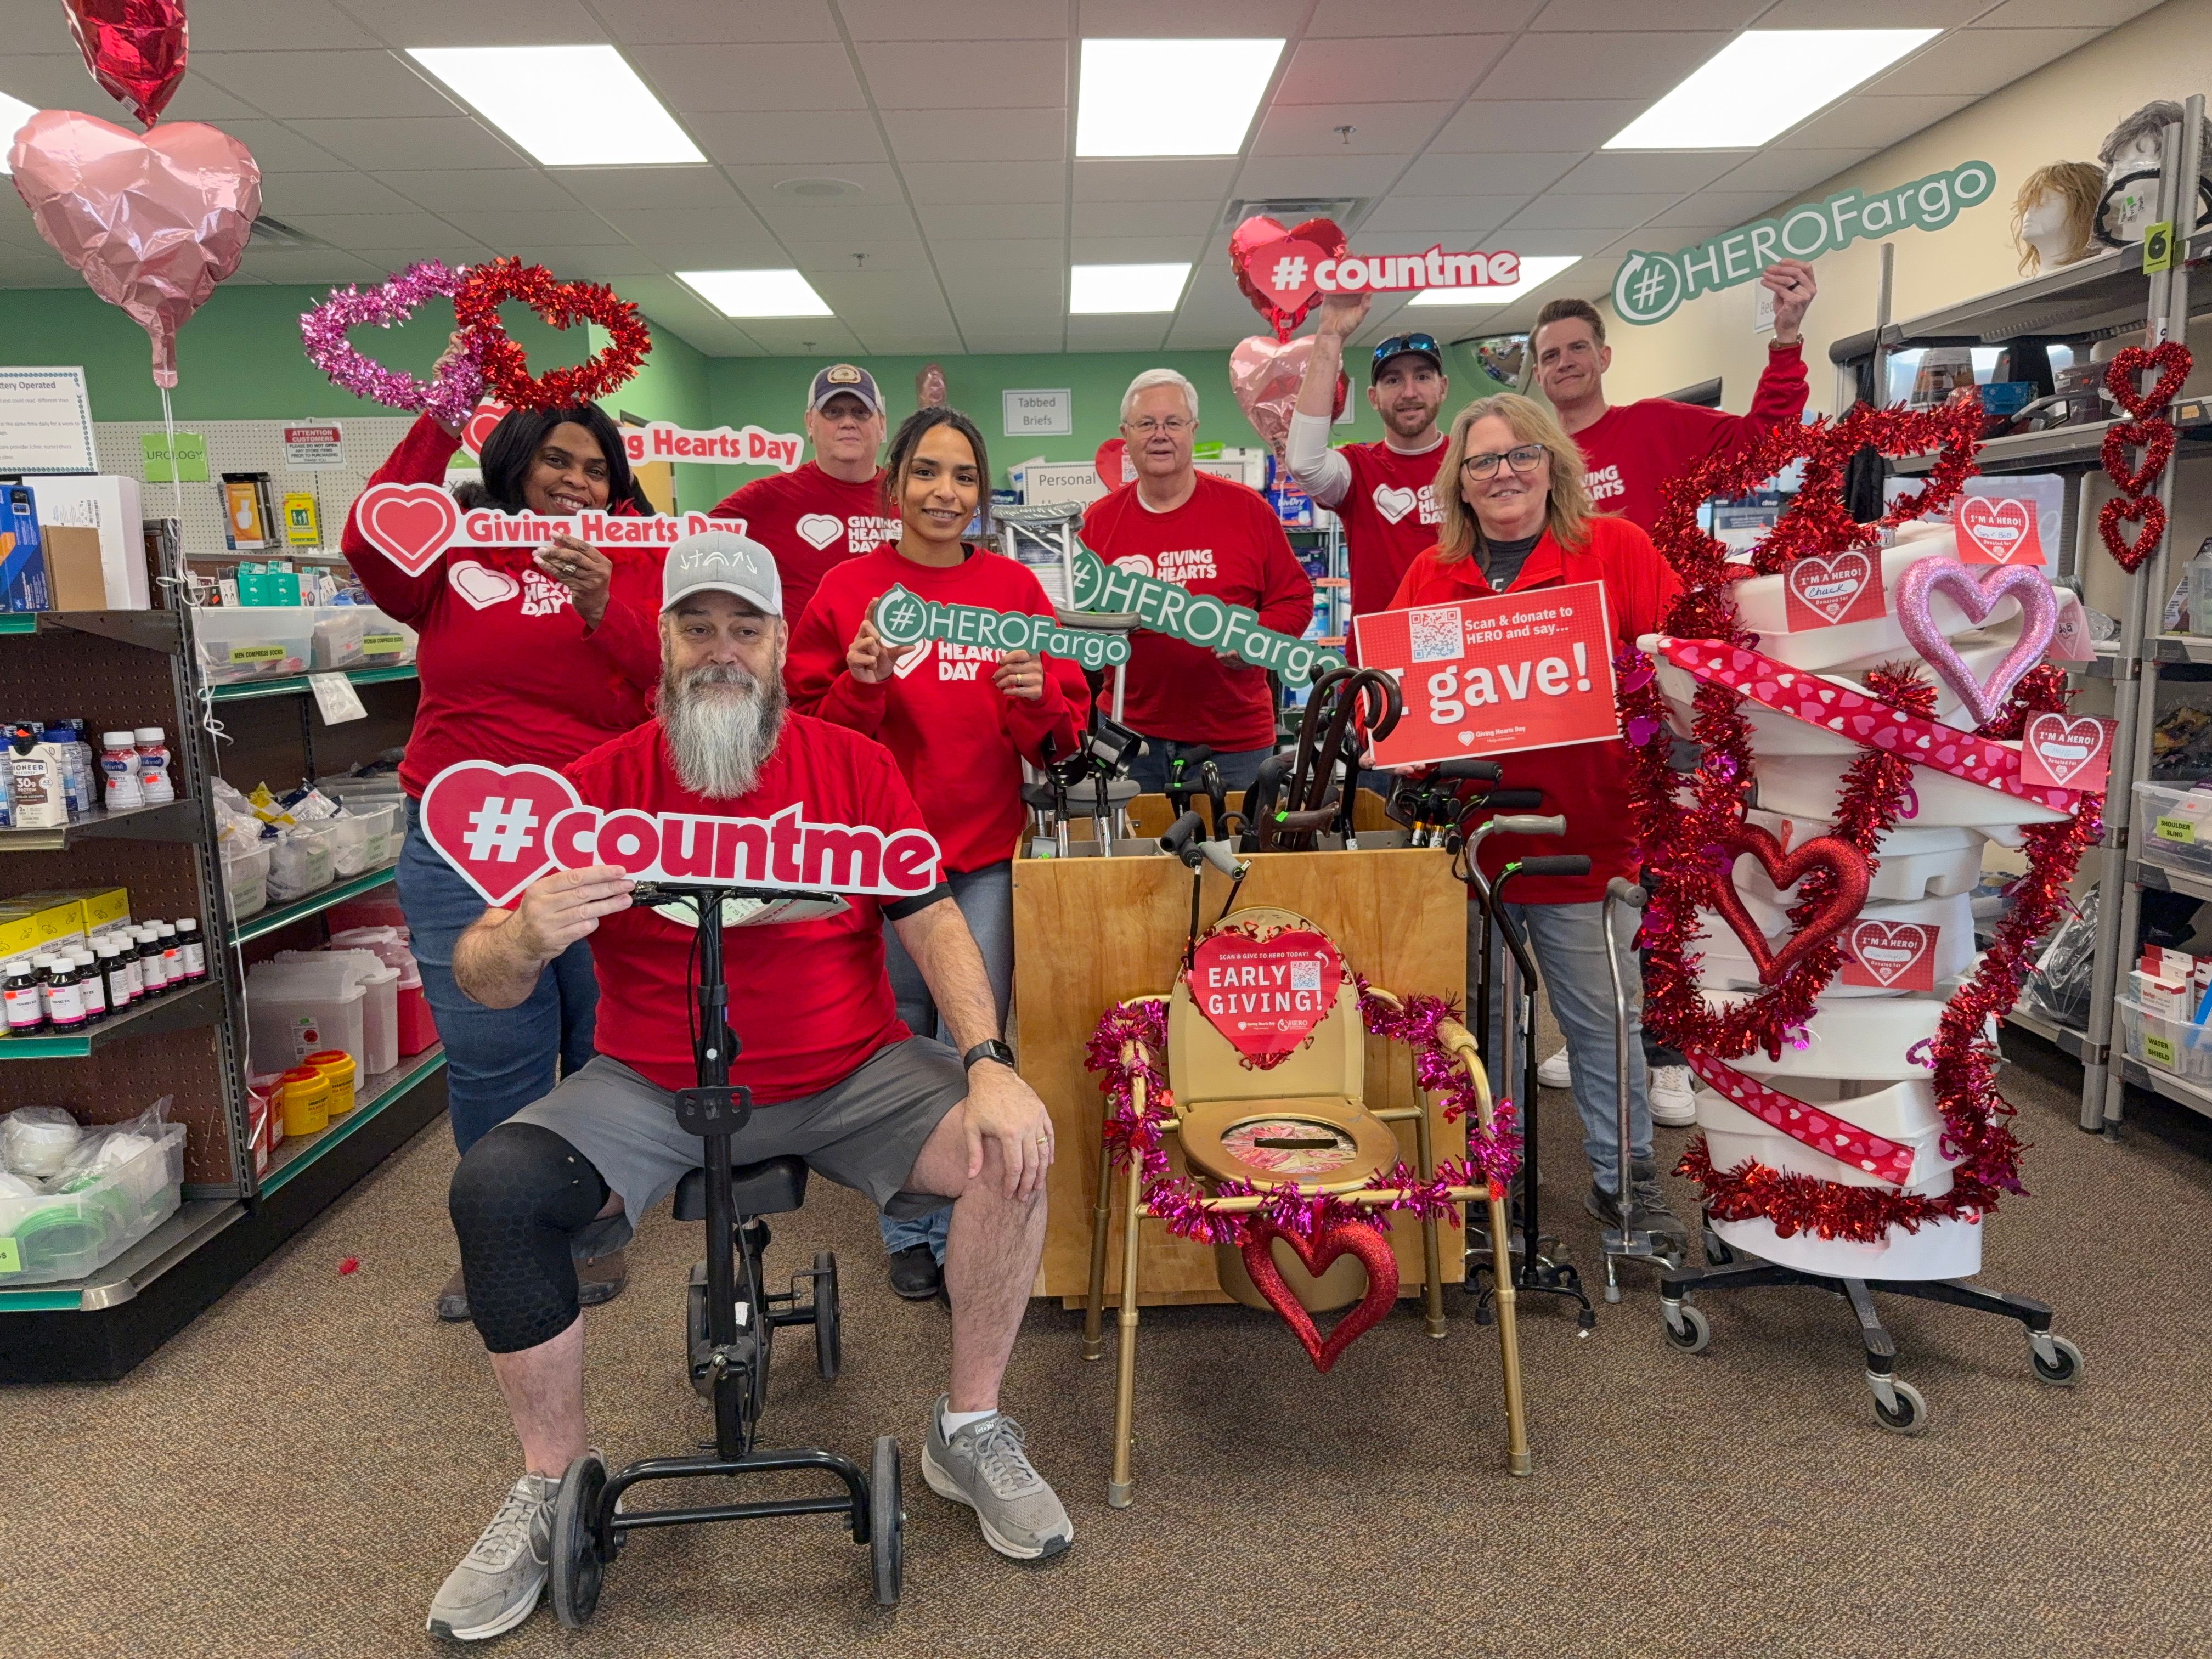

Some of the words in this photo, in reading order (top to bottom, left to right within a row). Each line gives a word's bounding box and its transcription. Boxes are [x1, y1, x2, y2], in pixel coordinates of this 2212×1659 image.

[1632, 168, 1987, 309] #HEROFargo
[2148, 229, 2167, 259] 6
[1271, 248, 1519, 290] #countme
[19, 381, 56, 391] Operated
[1018, 397, 1056, 408] Tabbed
[1023, 415, 1052, 426] Briefs
[147, 450, 203, 460] UROLOGY
[653, 428, 741, 458] Hearts
[749, 433, 797, 466] Day
[1039, 472, 1096, 486] Personal
[1579, 465, 1618, 487] VING
[581, 514, 678, 542] Hearts
[1971, 515, 1986, 523] I'M
[1996, 517, 2021, 526] HERO!
[849, 540, 881, 553] DAY
[1156, 549, 1213, 567] GIVING
[1156, 563, 1217, 583] HEARTS
[1801, 575, 1819, 585] I'M
[1832, 568, 1861, 580] HERO!
[521, 598, 565, 617] DAY
[1464, 618, 1496, 631] Scan
[1499, 615, 1509, 627] &
[1511, 610, 1558, 625] donate
[1559, 606, 1573, 617] to
[889, 602, 1127, 666] #HEROFargo
[1466, 630, 1503, 645] HERO
[1506, 627, 1531, 640] and
[1533, 623, 1569, 638] say...
[939, 662, 980, 681] DAY
[1427, 642, 1592, 725] gave!
[2039, 732, 2056, 741] I'M
[2067, 735, 2095, 745] HERO!
[16, 778, 36, 788] 30g
[2160, 820, 2190, 830] SHOULDER
[2166, 830, 2183, 838] SLING
[463, 796, 937, 891] #countme
[1890, 940, 1918, 949] HERO!
[1209, 965, 1286, 988] EARLY
[1209, 991, 1323, 1015] GIVING!
[2148, 1037, 2169, 1049] WATER
[2148, 1048, 2170, 1061] SHIELD
